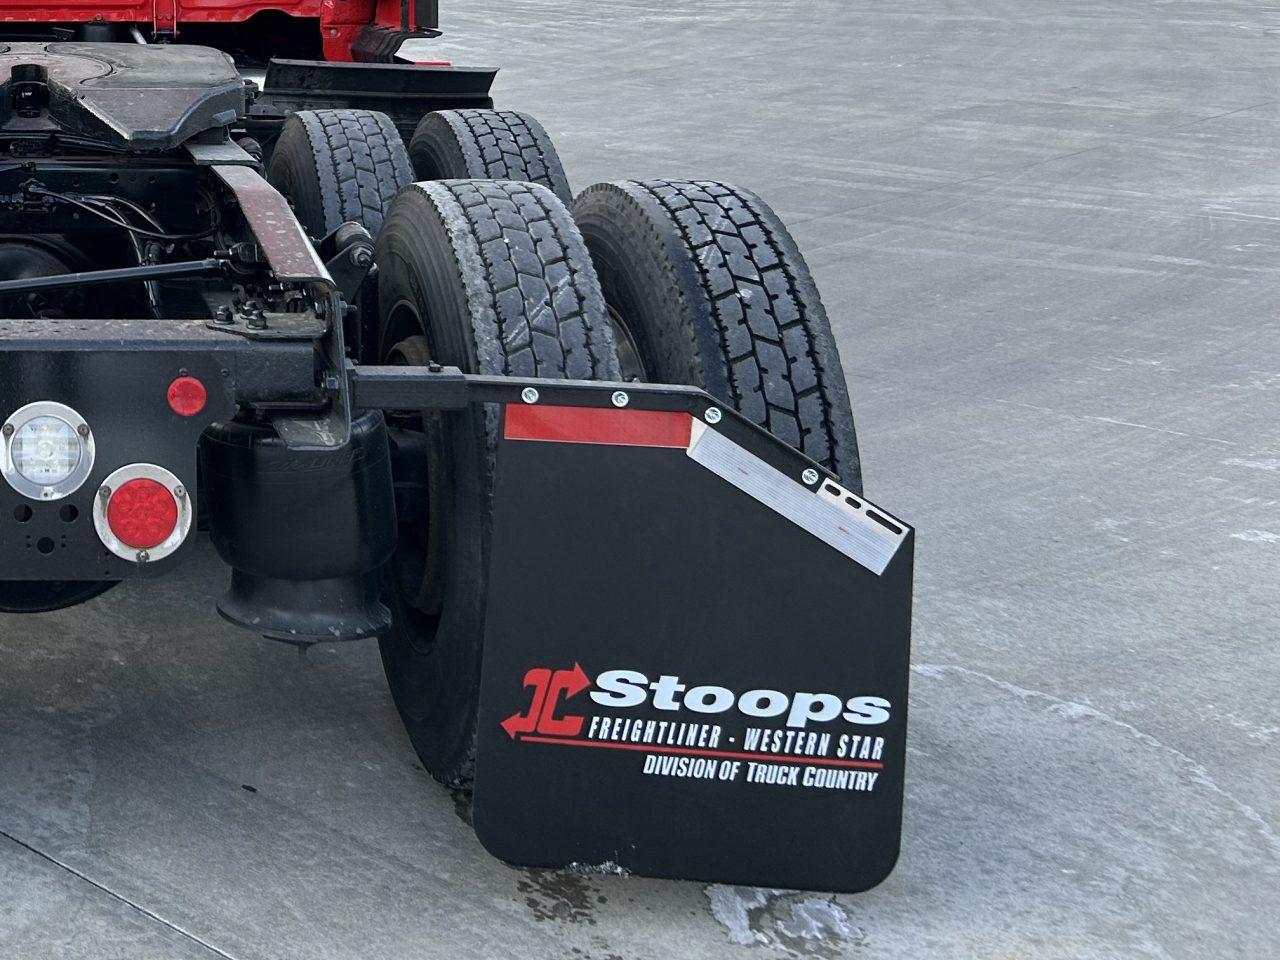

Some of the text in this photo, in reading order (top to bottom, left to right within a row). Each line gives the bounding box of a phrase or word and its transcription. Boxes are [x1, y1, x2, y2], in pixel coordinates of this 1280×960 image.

[589, 669, 892, 729] Stoops
[588, 716, 721, 749] FREIGHTLINER
[743, 727, 830, 757] WESTERN
[837, 733, 885, 761] STAR
[642, 754, 879, 792] DIVISION OF TRUCK COUNTRY
